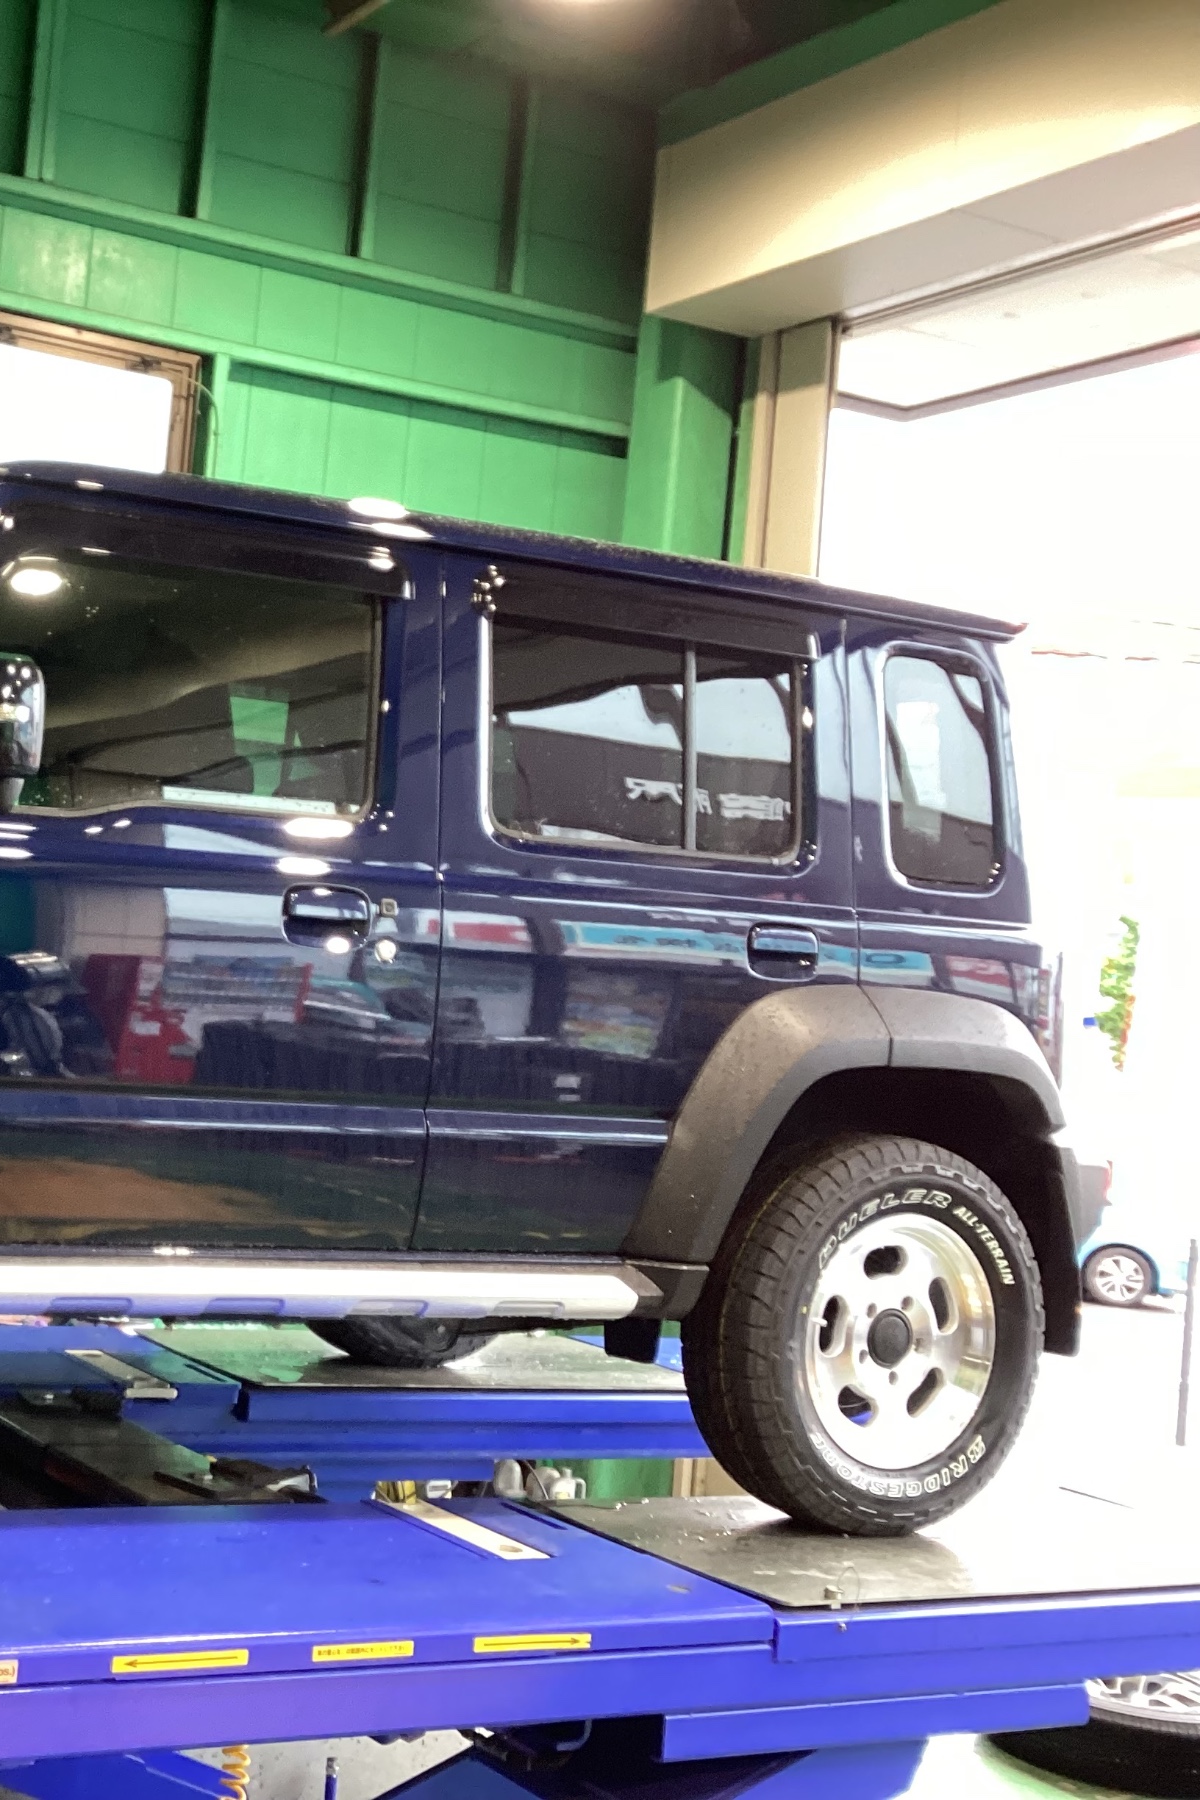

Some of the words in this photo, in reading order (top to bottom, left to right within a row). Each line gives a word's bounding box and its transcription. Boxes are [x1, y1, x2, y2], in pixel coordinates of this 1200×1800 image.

[818, 1188, 953, 1270] DUELER
[952, 1205, 1016, 1286] ALL-TERRAIN
[809, 1432, 987, 1498] BRIDGESTONE
